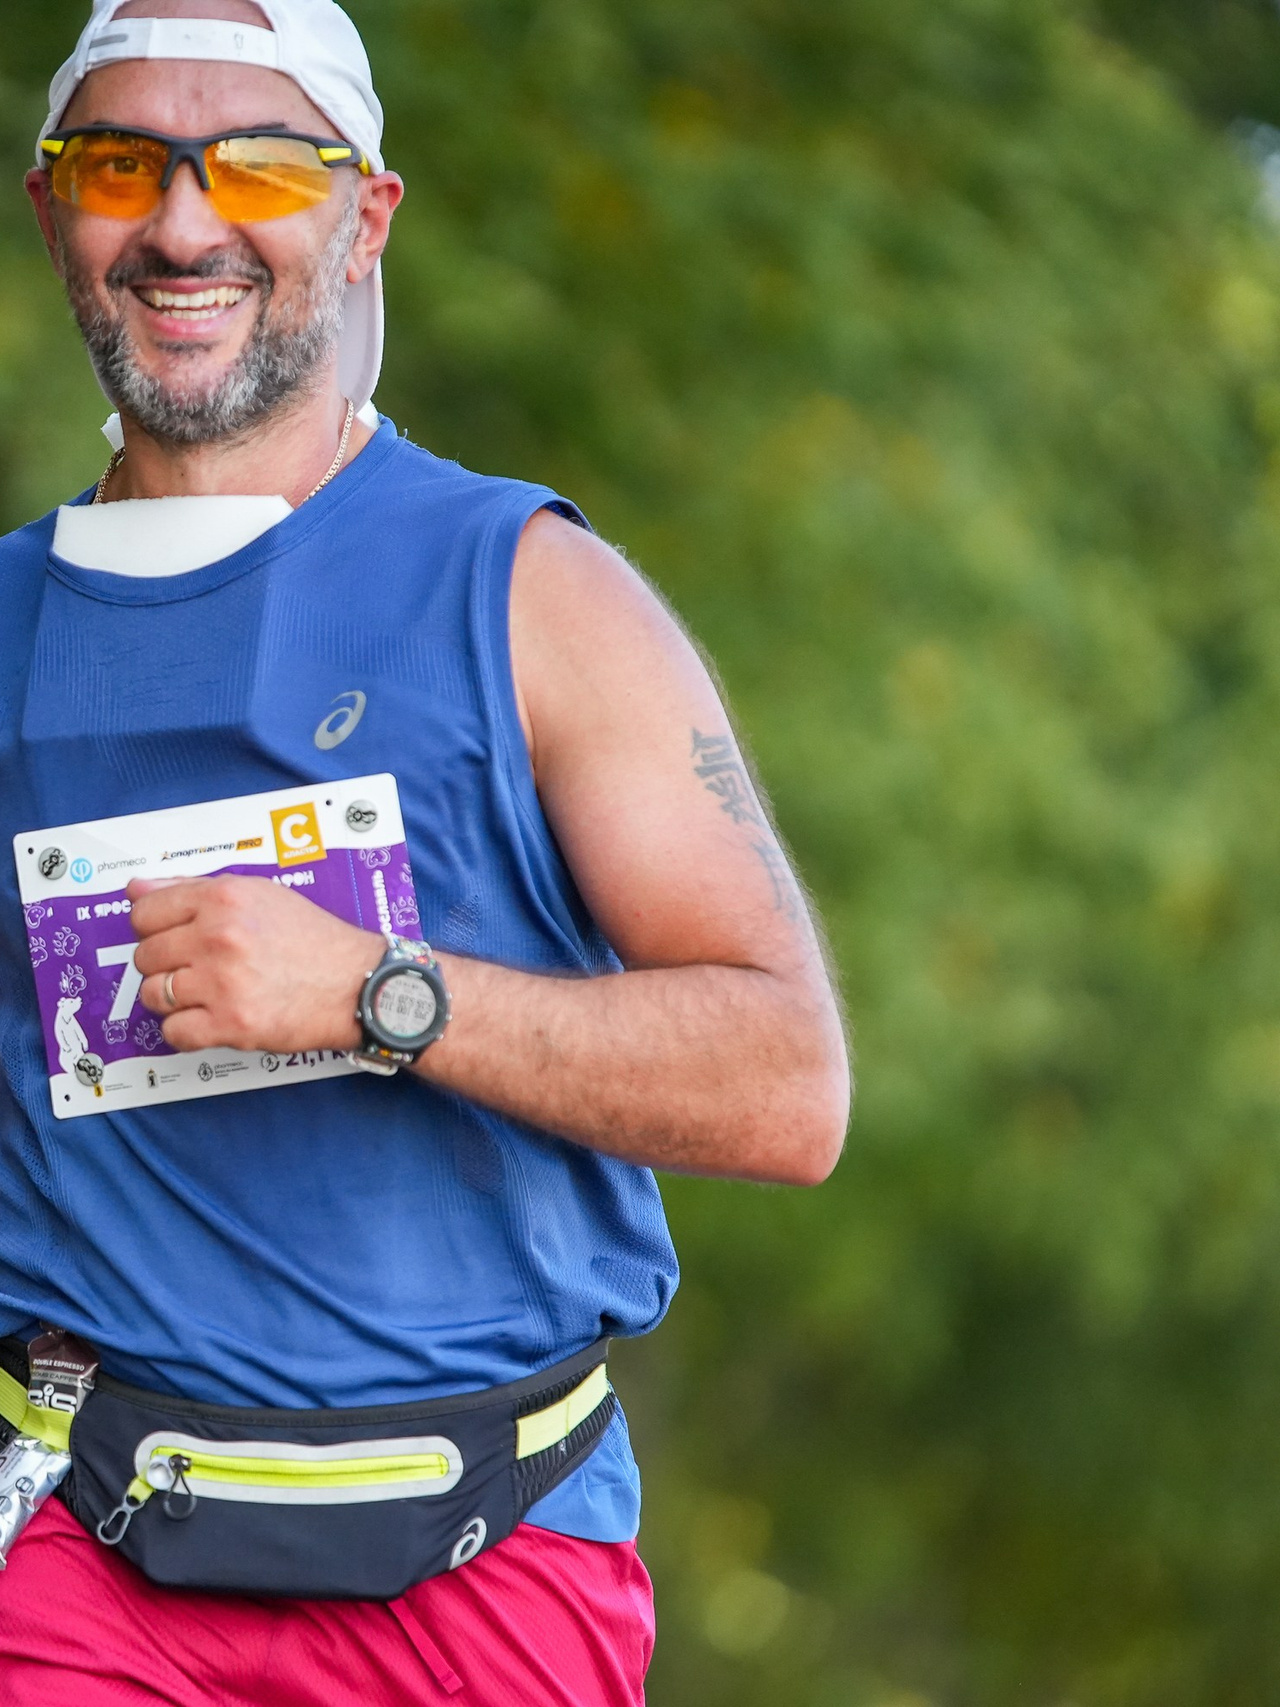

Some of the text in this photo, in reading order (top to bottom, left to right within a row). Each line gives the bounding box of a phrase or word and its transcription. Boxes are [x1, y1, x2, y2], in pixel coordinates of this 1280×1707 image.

[238, 837, 263, 850] PRO
[97, 856, 147, 873] pharmeco
[96, 942, 144, 1021] 7
[53, 1360, 85, 1371] ESPRESSO
